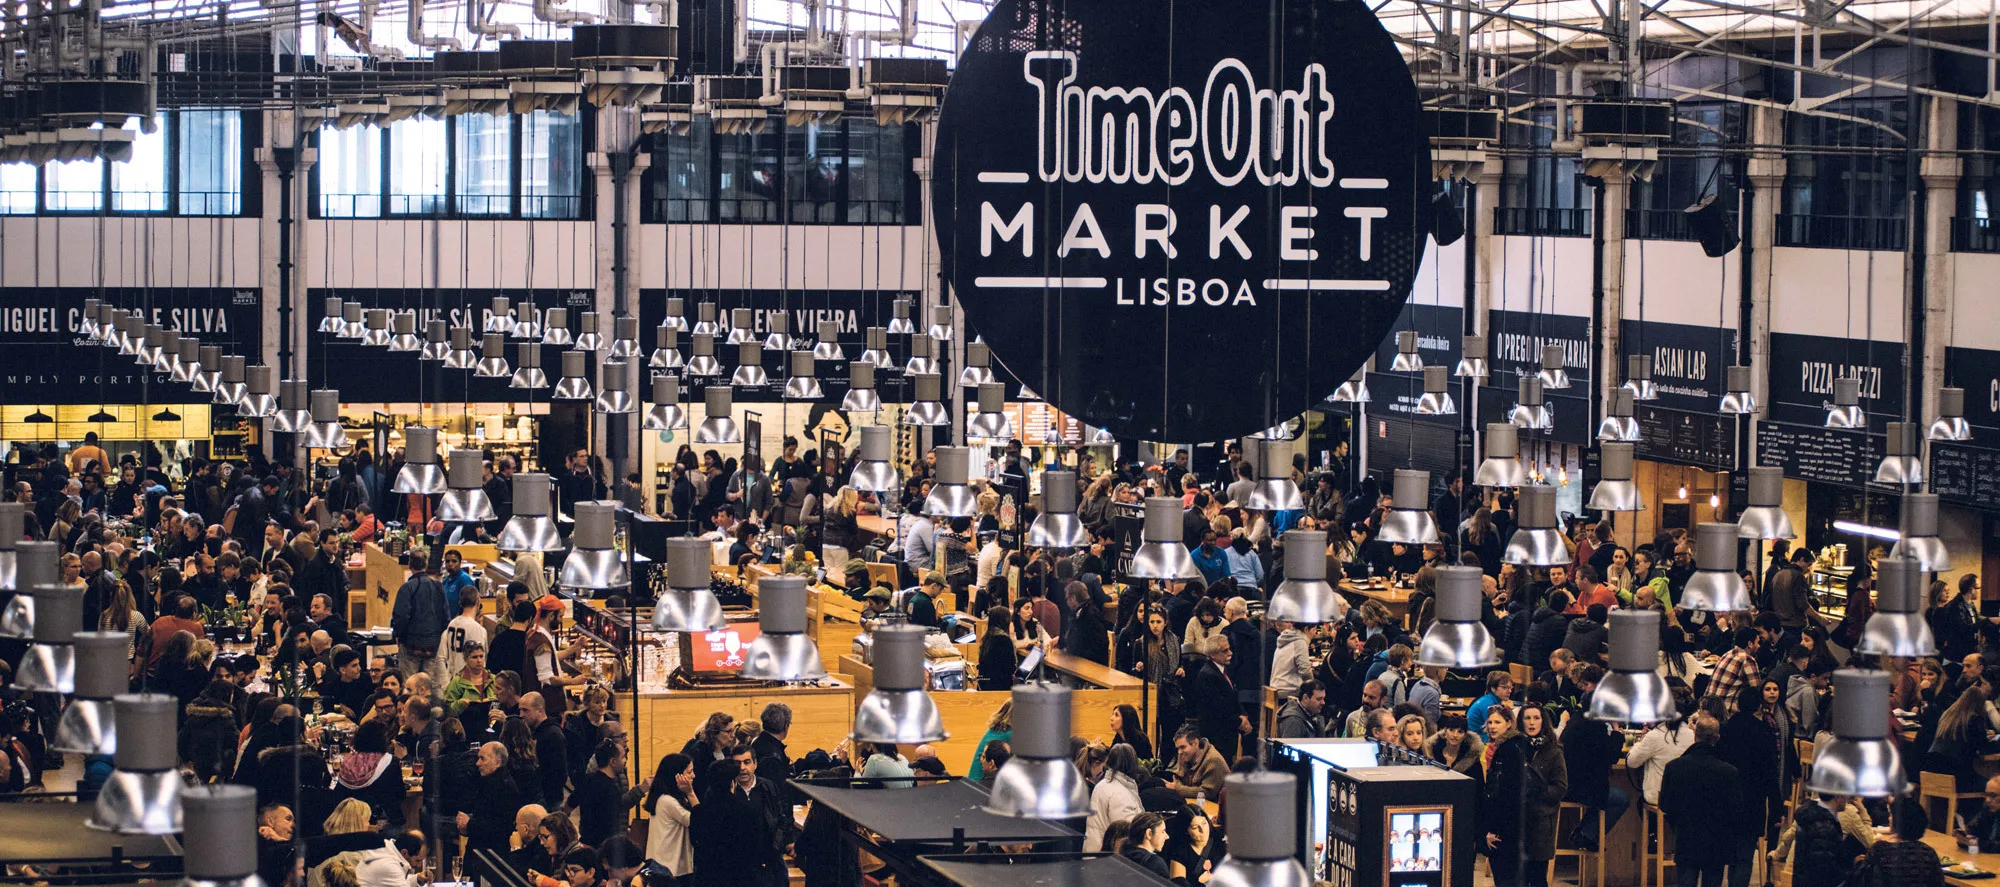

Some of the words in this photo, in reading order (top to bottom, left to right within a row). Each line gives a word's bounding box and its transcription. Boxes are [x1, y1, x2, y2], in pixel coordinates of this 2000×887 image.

[1024, 50, 1197, 185] Time
[1202, 57, 1335, 187] Out
[980, 201, 1388, 262] MARKET
[1116, 277, 1257, 306] LISBOA
[0, 308, 59, 333] IGUEL
[171, 308, 227, 333] SILVA
[450, 304, 474, 332] SÁ
[1497, 332, 1503, 360] O
[1505, 333, 1532, 363] PREGO
[1549, 338, 1588, 369] XARIA
[1654, 346, 1684, 378] ASIAN
[1687, 350, 1707, 381] LAB
[1802, 361, 1834, 395] PIZZA
[1990, 378, 2000, 413] C
